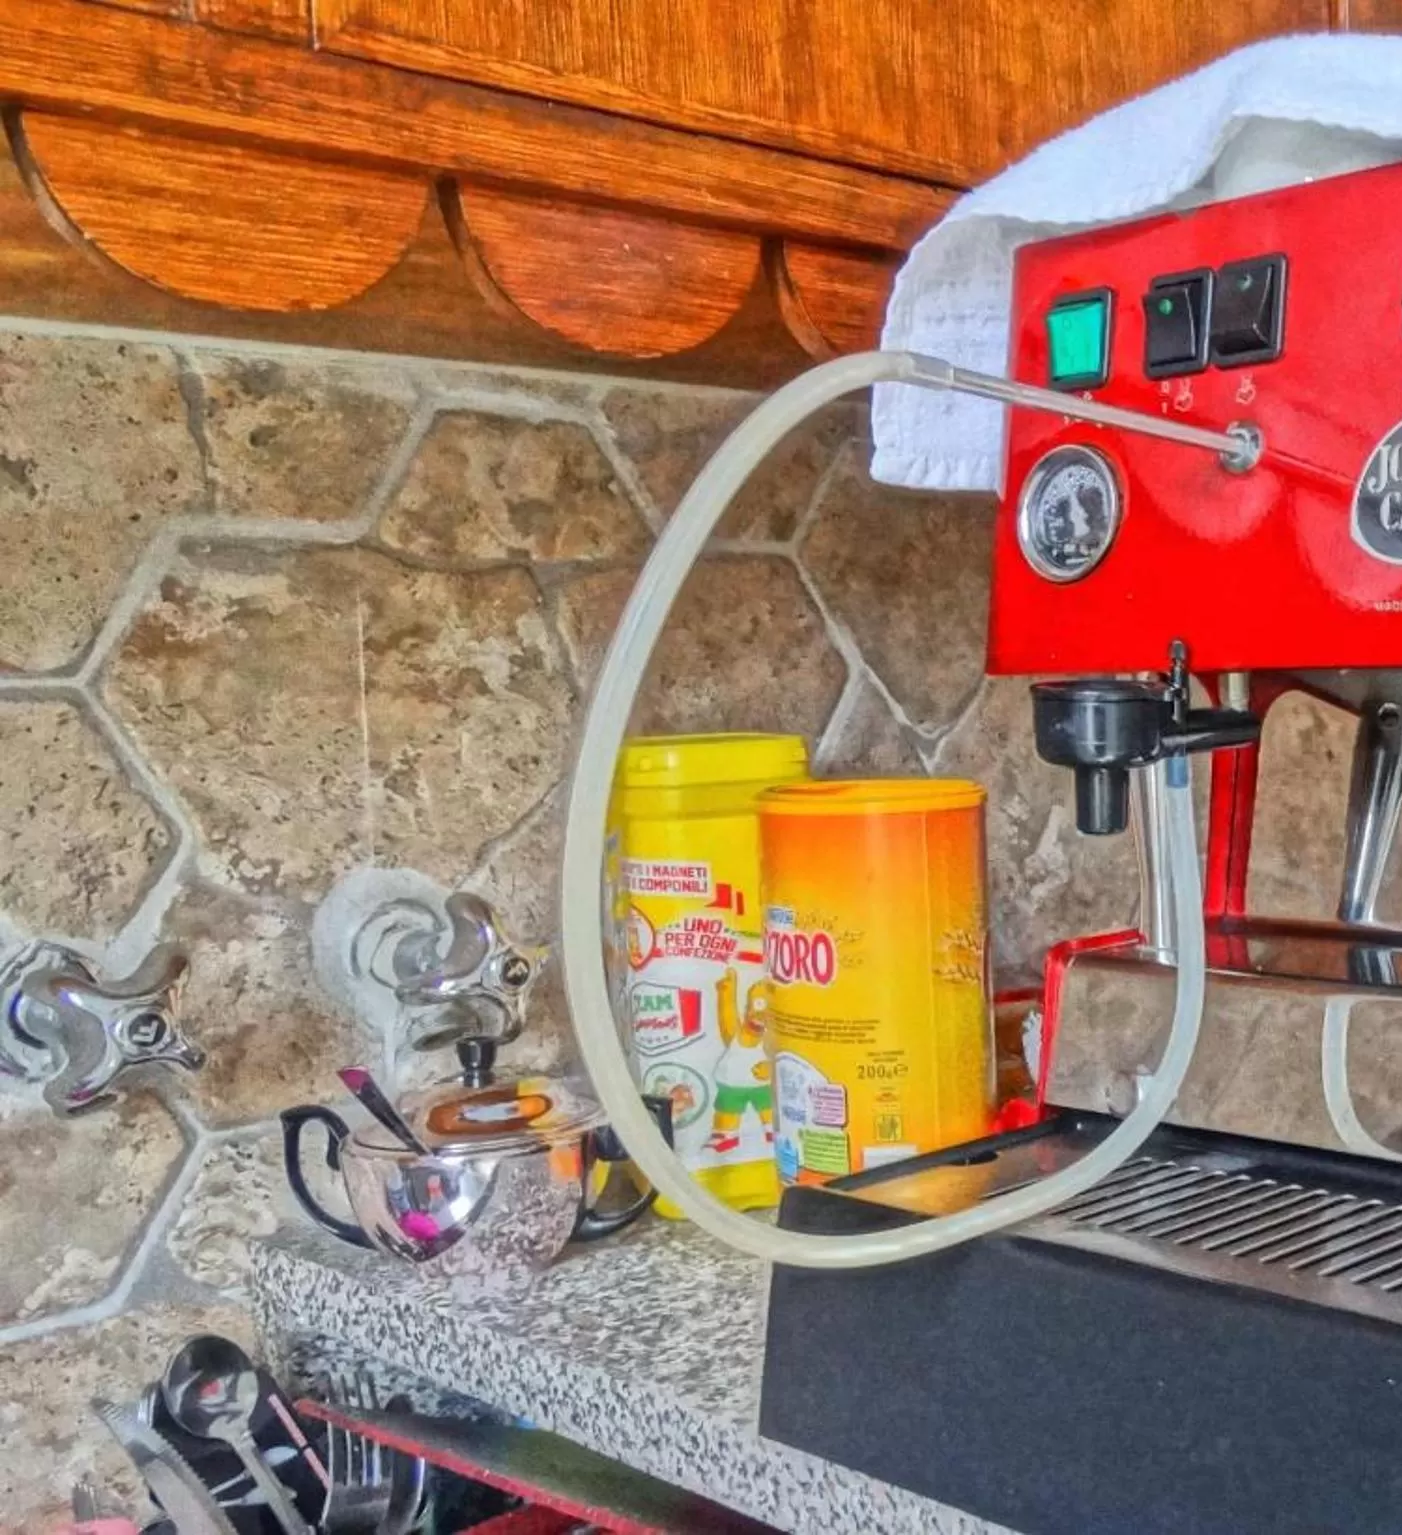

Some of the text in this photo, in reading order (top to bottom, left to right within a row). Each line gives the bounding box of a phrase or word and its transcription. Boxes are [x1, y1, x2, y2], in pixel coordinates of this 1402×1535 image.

[652, 866, 707, 879] MAGNETI
[684, 917, 723, 934] UNO
[665, 932, 738, 952] PER OGNI
